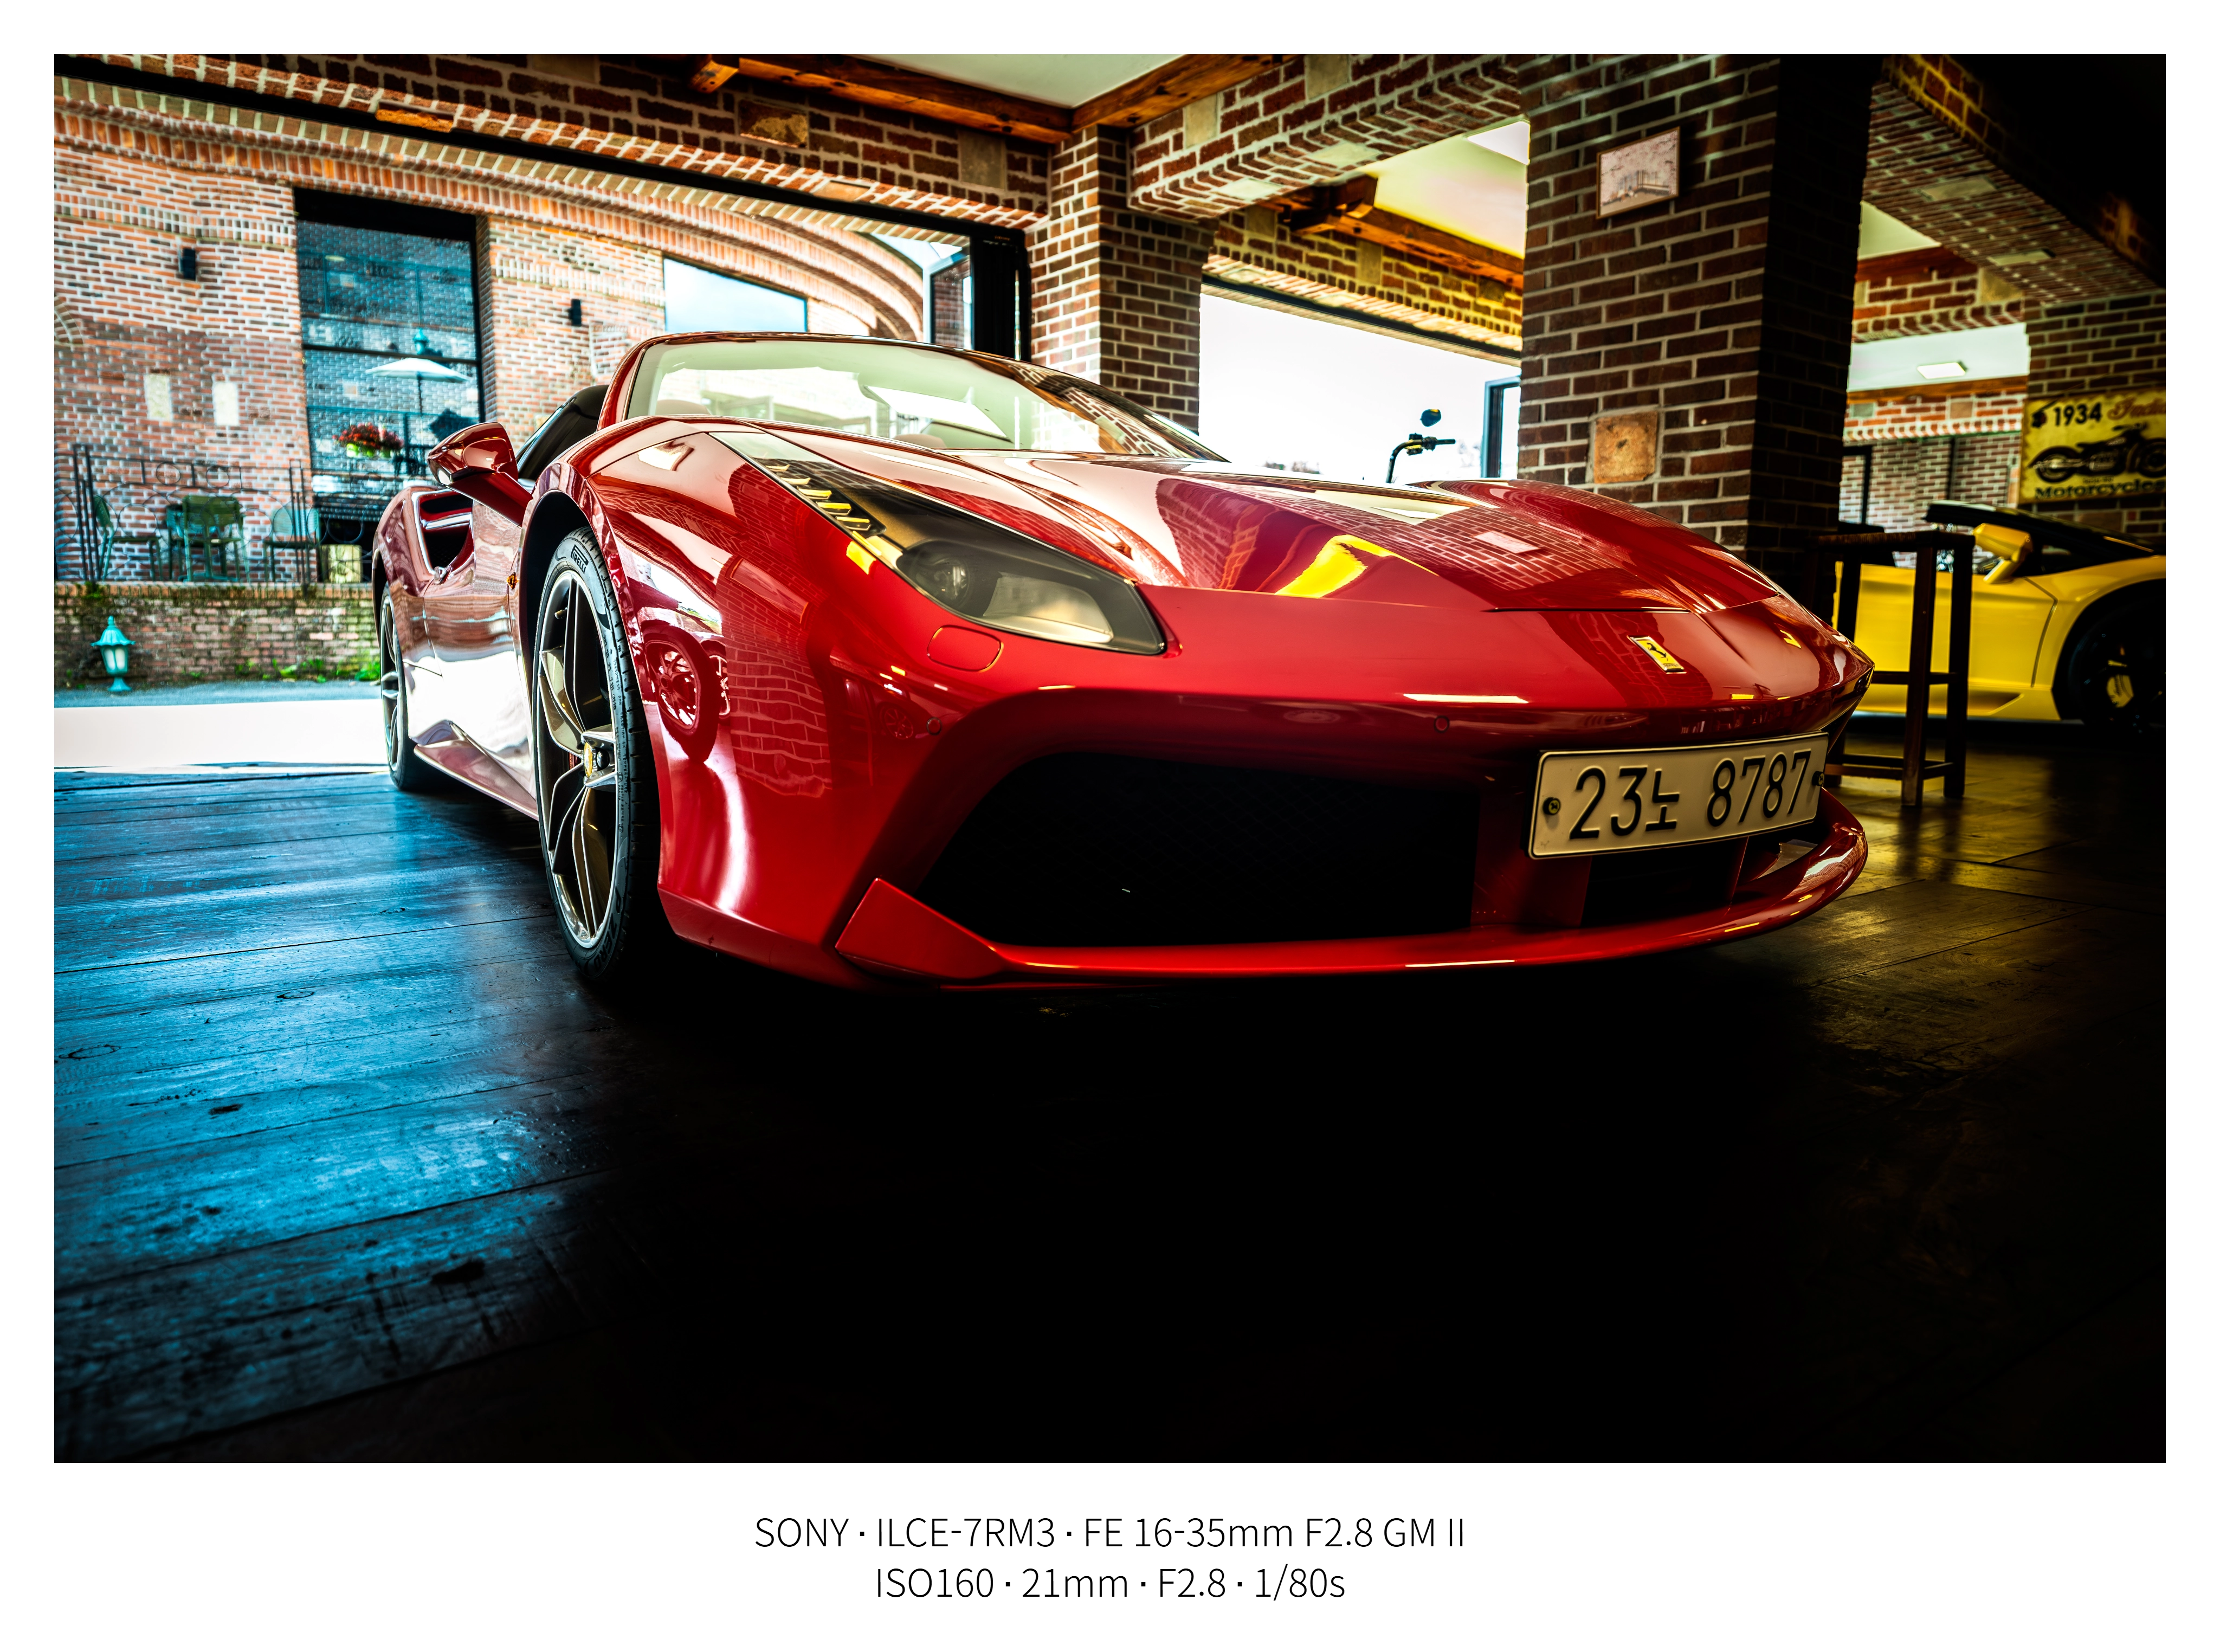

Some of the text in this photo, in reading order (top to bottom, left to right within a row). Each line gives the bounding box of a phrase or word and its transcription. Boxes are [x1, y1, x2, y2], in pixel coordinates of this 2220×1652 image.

[2053, 402, 2102, 427] 1934
[2035, 479, 2165, 499] Motorcycles
[570, 544, 589, 575] PIRELLI
[1569, 750, 1812, 840] 23노 8787
[593, 886, 621, 972] P ZERO
